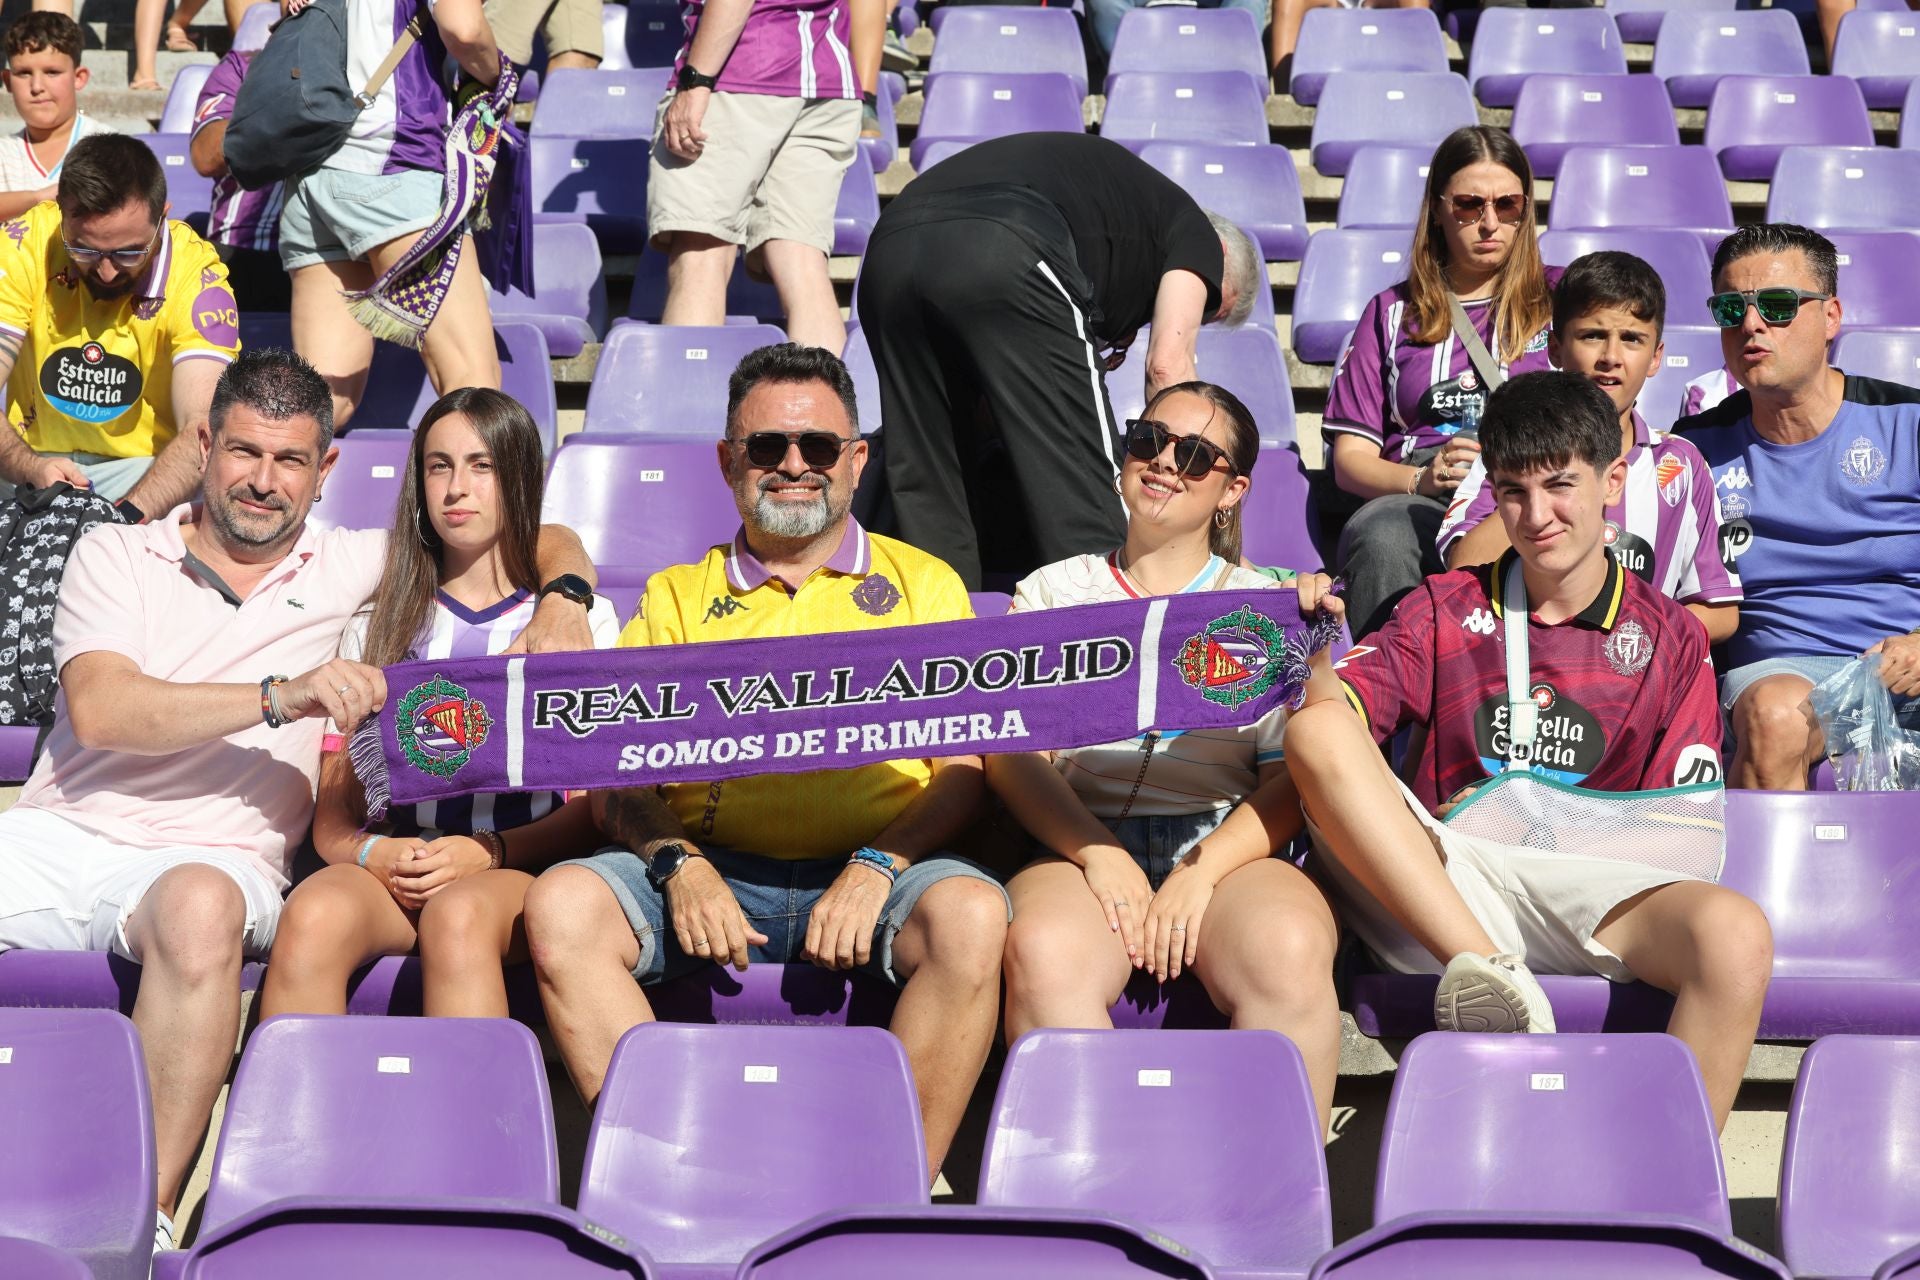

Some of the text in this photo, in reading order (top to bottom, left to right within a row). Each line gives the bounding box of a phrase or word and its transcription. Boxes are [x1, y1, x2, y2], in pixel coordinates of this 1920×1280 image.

[424, 284, 445, 319] COPA
[440, 268, 452, 285] DE
[58, 356, 127, 386] Estrella
[57, 376, 122, 404] Galicia
[75, 402, 99, 419] 0,0
[532, 635, 1133, 737] REAL VALLADOLID
[618, 709, 1030, 770] SOMOS DE PRIMERA
[1677, 757, 1717, 784] JD
[1539, 1077, 1558, 1089] 187
